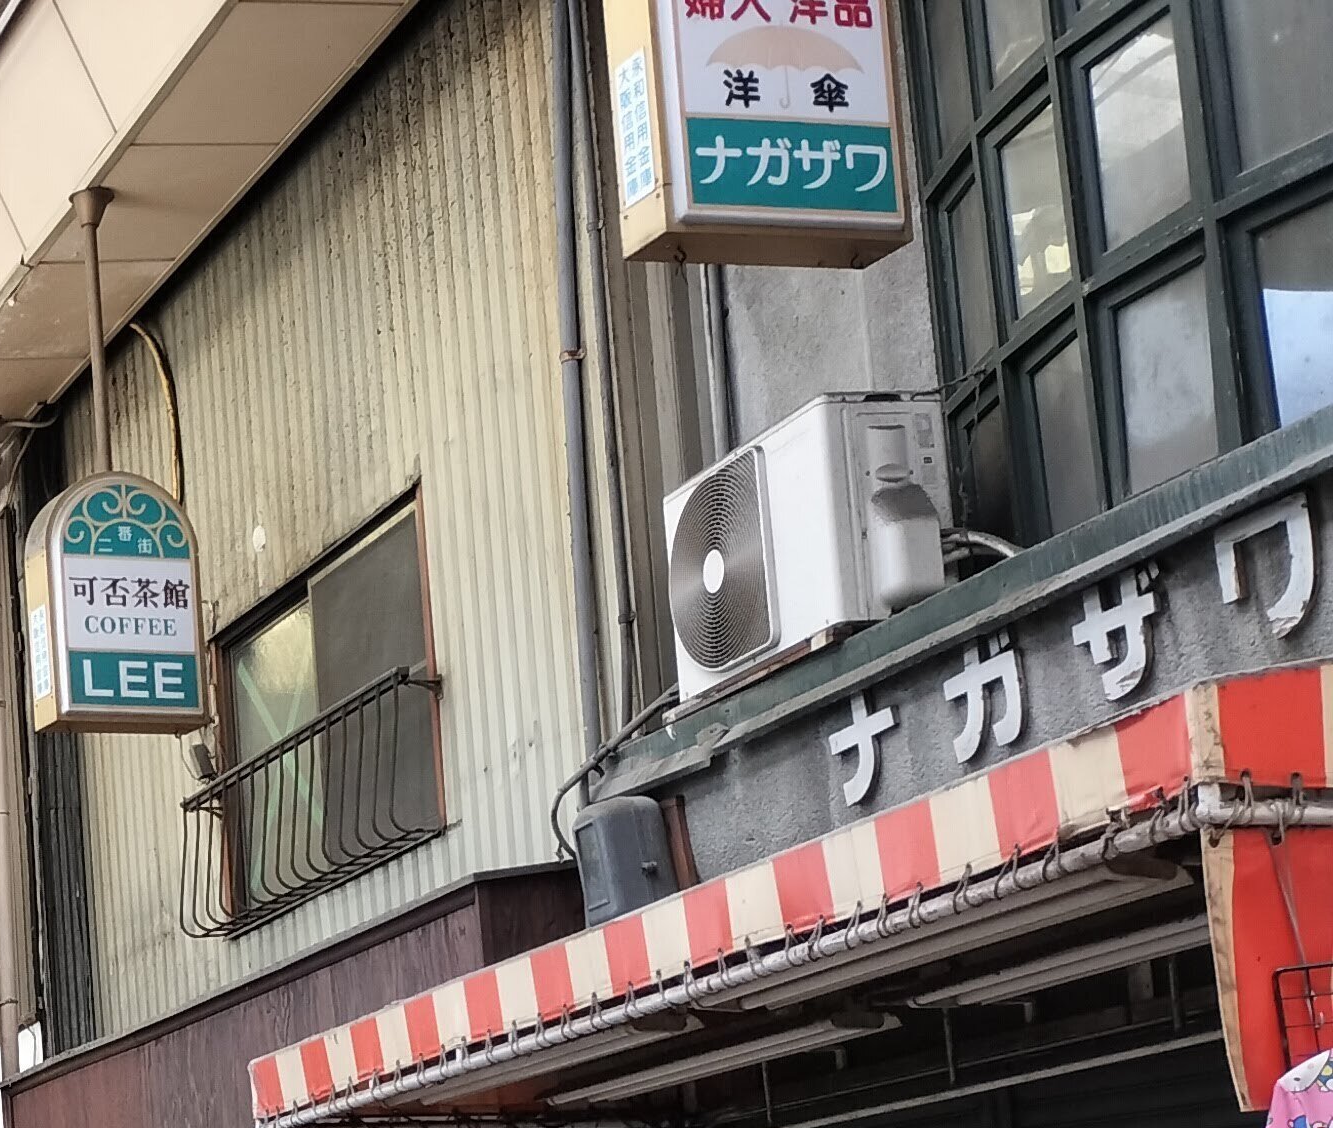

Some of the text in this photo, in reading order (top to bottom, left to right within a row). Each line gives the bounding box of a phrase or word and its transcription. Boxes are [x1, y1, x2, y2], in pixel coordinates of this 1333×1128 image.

[695, 135, 888, 192] ナガザワ
[98, 525, 153, 555] 二番街
[68, 576, 190, 610] 可否茶館
[84, 615, 178, 636] COFFEE
[828, 492, 1318, 806] ナガザワ
[82, 659, 185, 699] LEE
